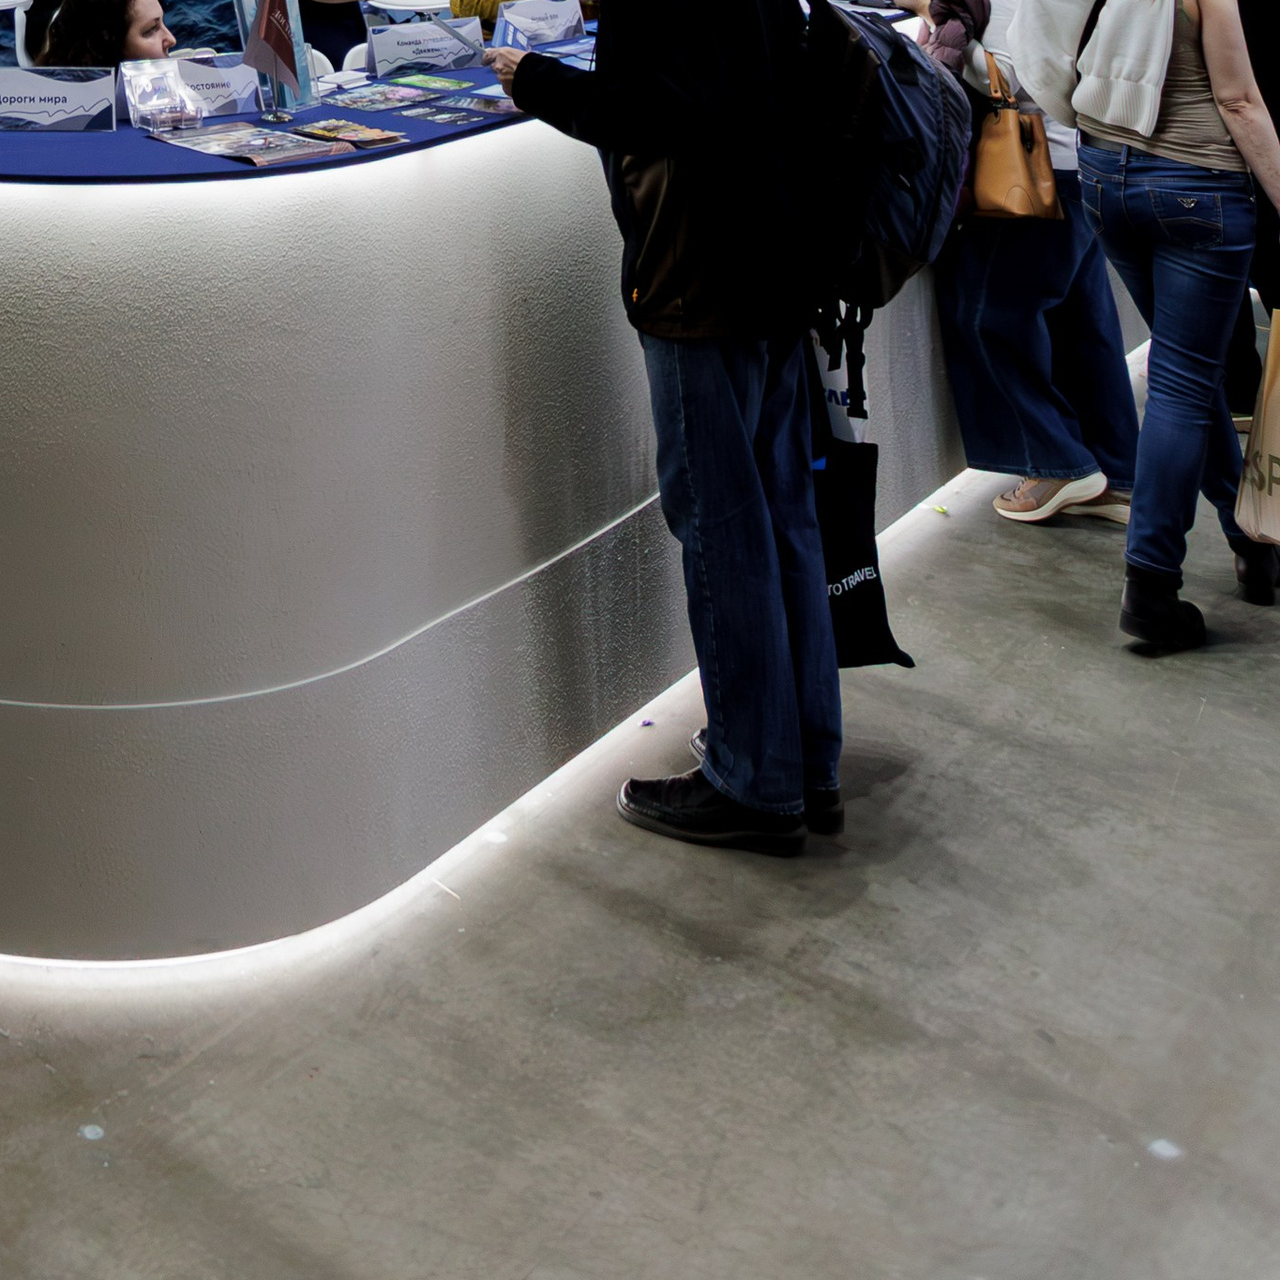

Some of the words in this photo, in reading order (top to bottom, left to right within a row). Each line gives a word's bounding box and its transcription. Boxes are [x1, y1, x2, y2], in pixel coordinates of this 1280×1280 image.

[185, 81, 231, 91] остояние
[38, 95, 68, 106] мира
[842, 565, 877, 591] TRAVEL
